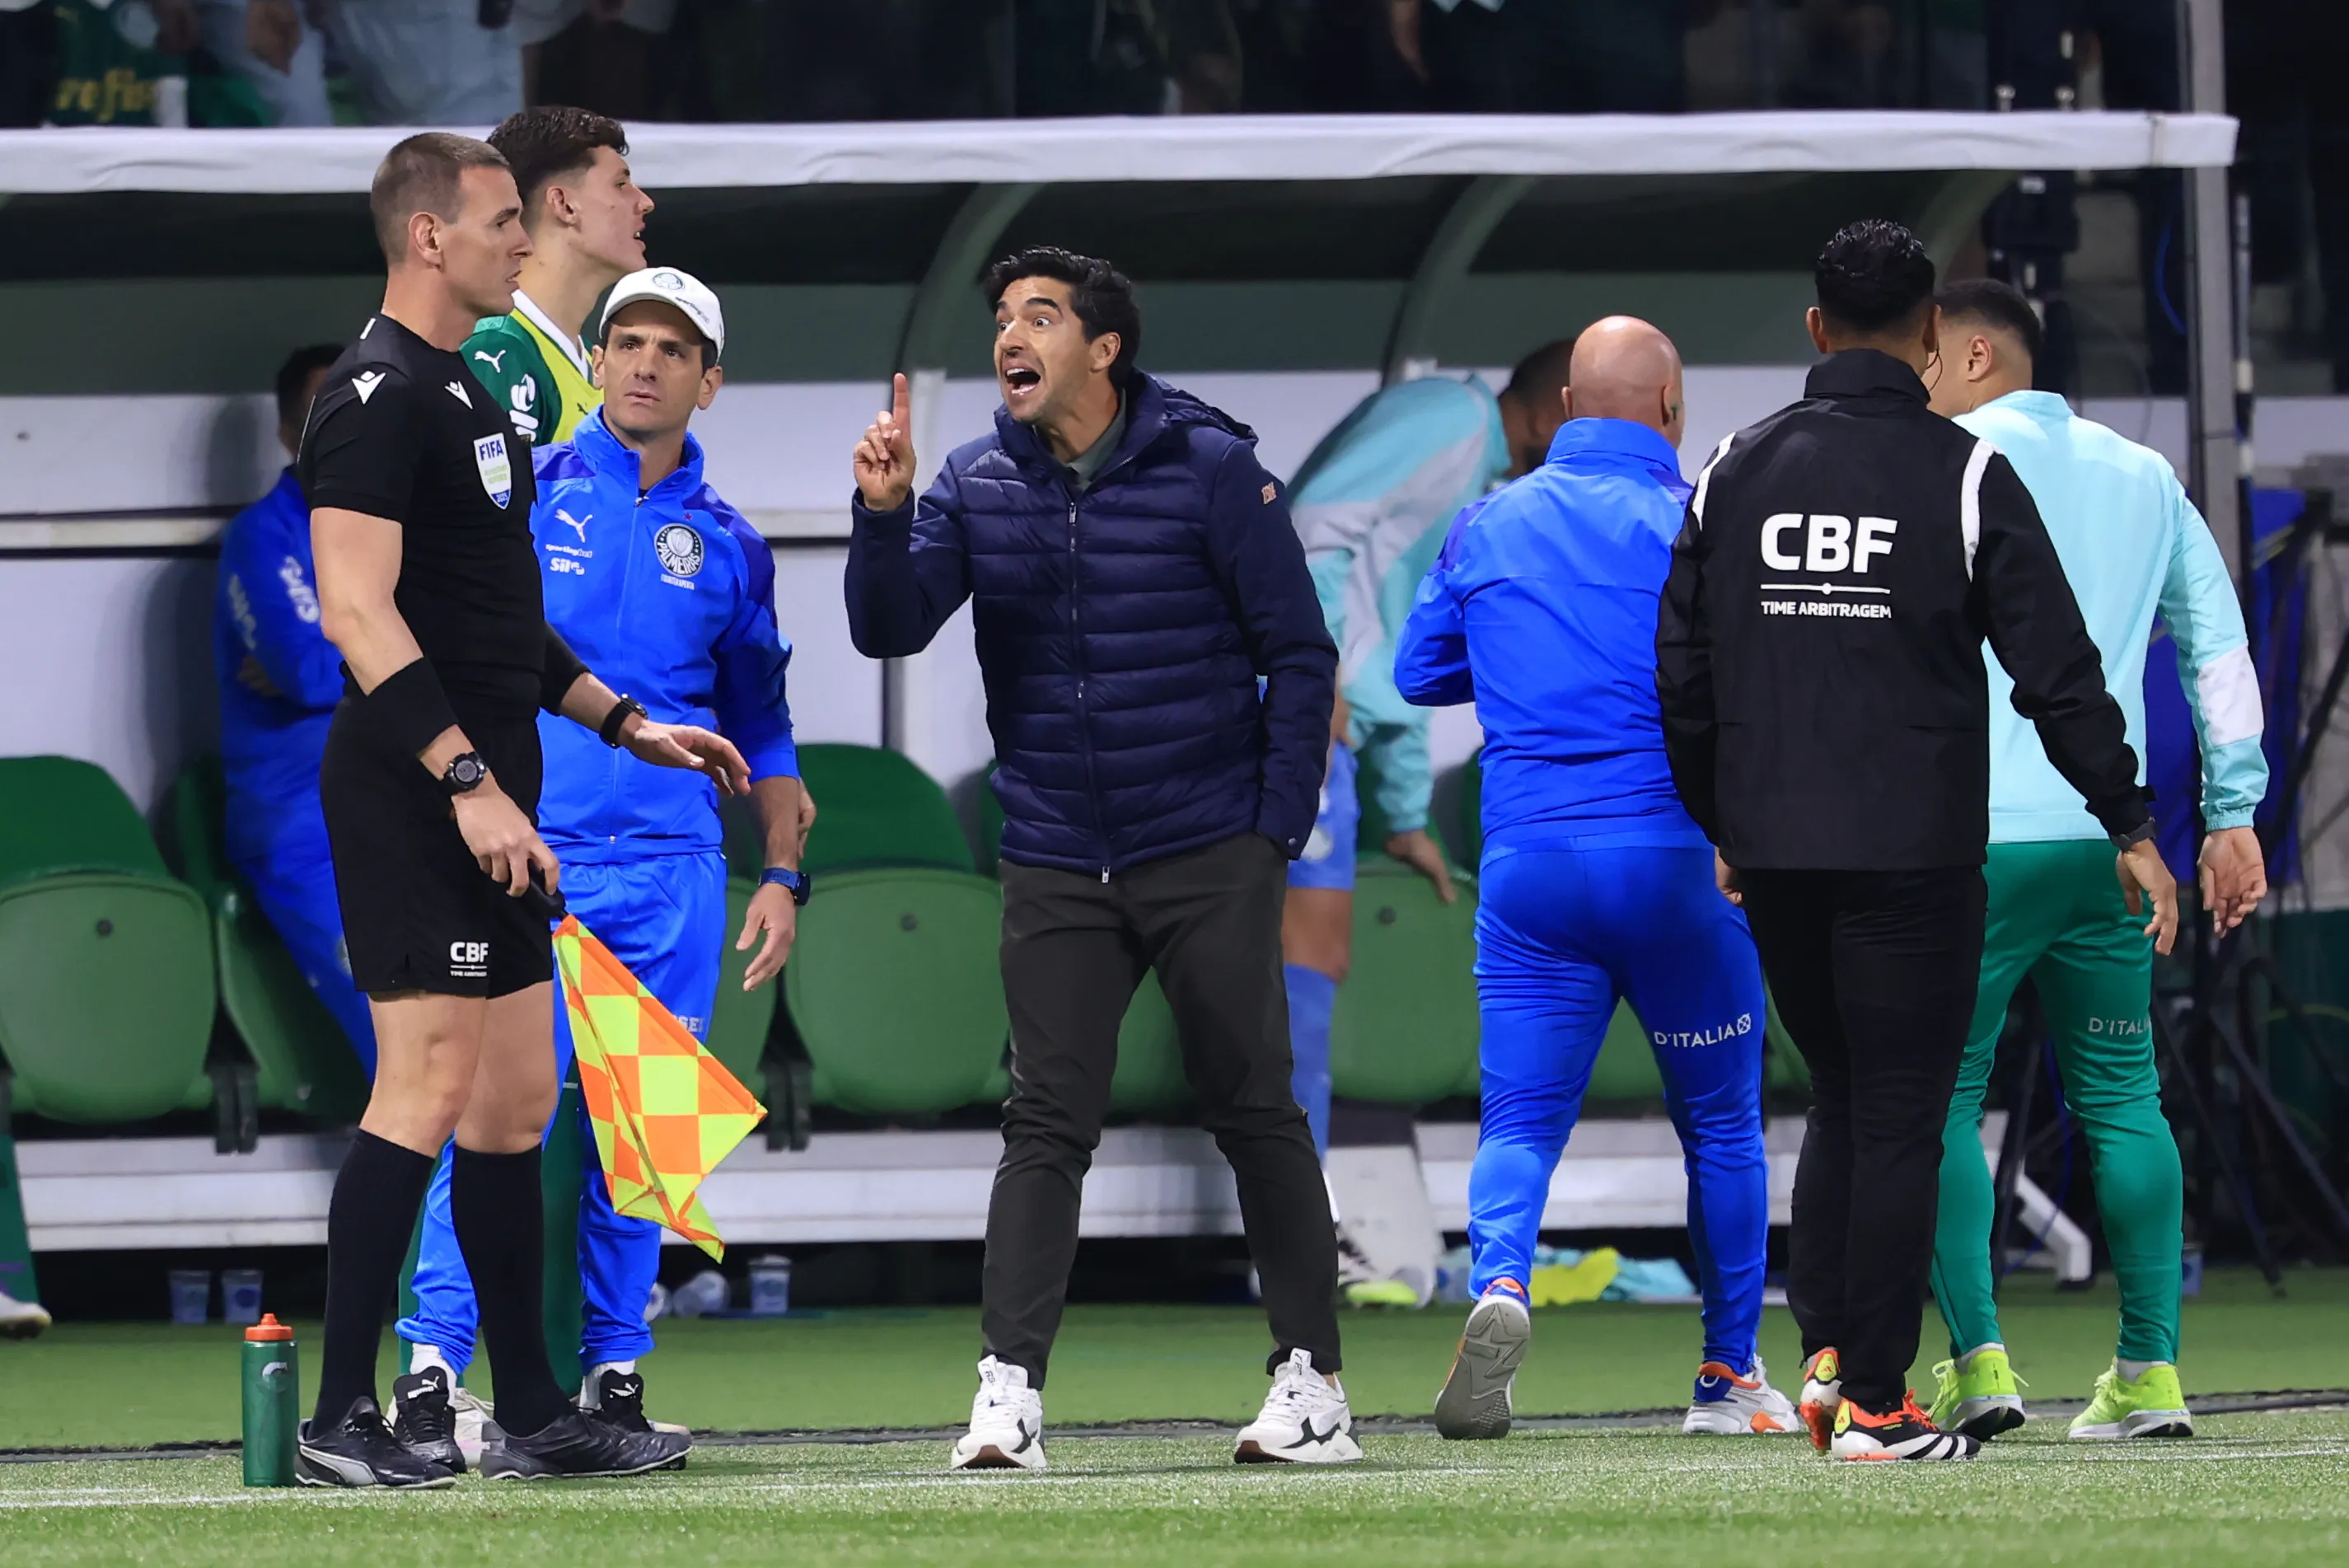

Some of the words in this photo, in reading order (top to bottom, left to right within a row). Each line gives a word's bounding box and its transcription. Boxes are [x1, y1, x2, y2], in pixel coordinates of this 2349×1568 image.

[479, 439, 504, 461] FIFA
[1761, 513, 1898, 573] CBF
[657, 541, 701, 575] PALMEIRAS
[1760, 601, 1797, 615] TIME
[1798, 601, 1892, 619] ARBITRAGEM
[450, 941, 489, 963] CBF
[1654, 1023, 1736, 1048] D'ITALIA
